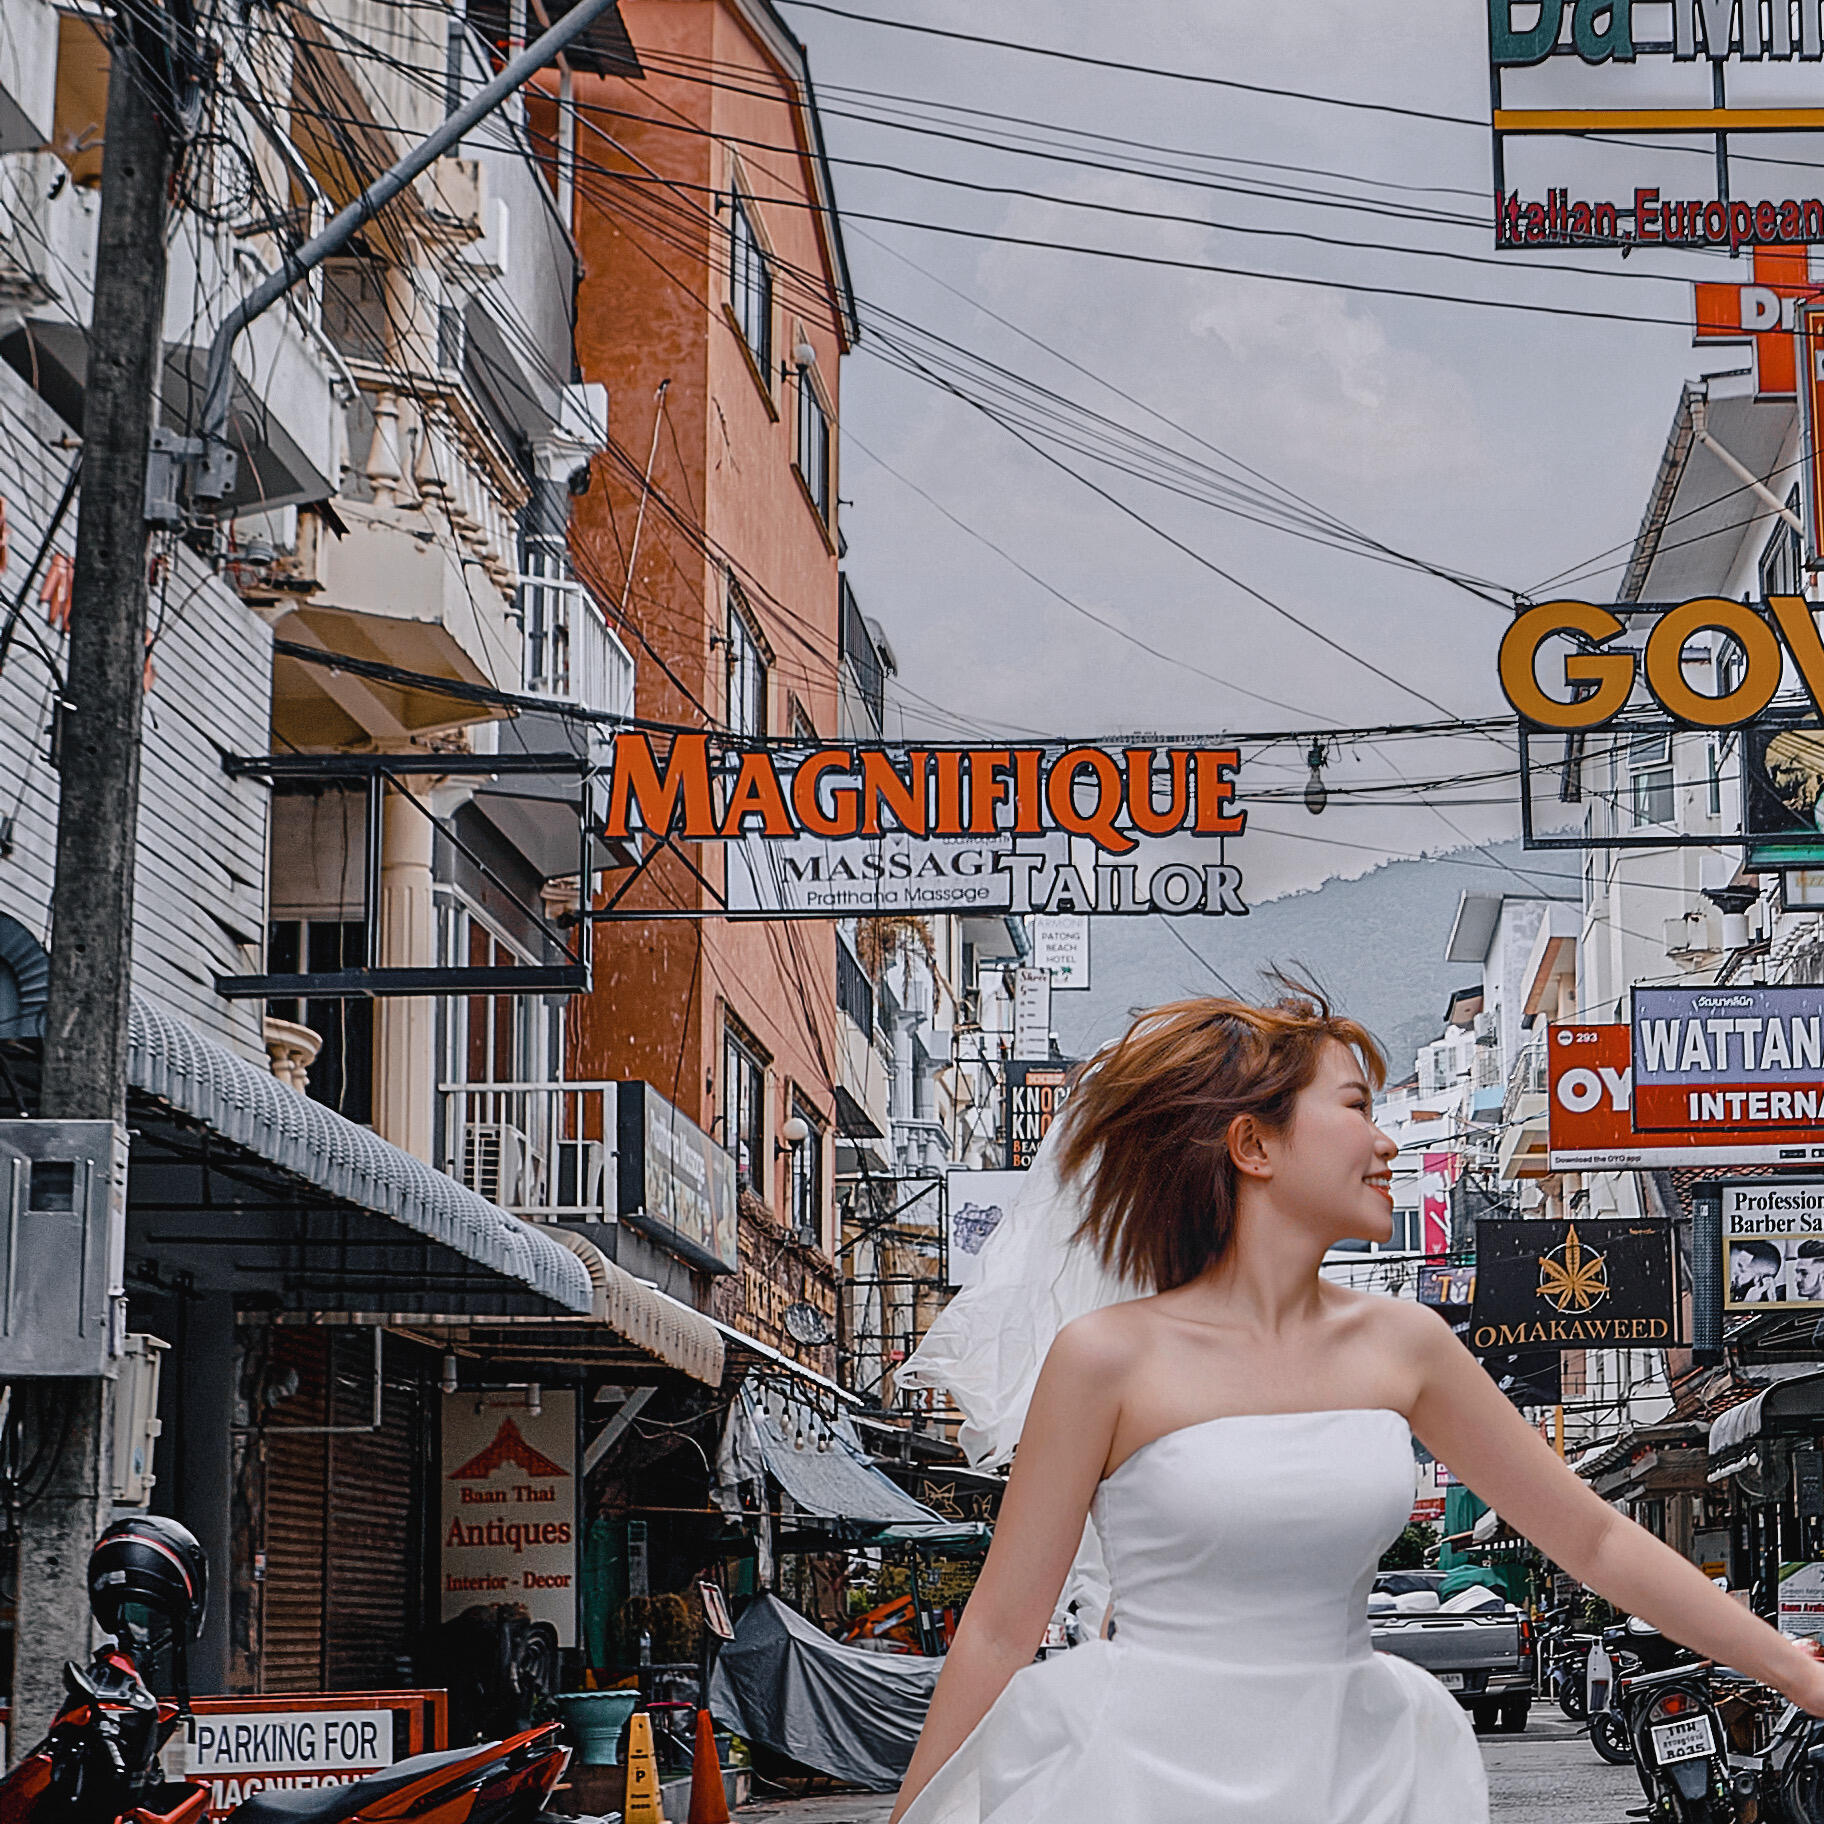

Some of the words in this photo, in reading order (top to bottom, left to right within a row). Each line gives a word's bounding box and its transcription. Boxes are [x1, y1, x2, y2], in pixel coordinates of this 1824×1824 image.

[602, 731, 1250, 855] MAGNIFIQUE
[807, 889, 898, 906] Pratthana
[904, 885, 990, 903] Massage
[997, 853, 1249, 916] TAILOR
[1012, 1086, 1072, 1113] KNOC
[1557, 1067, 1632, 1113] OY
[1730, 1213, 1796, 1233] Barber
[1474, 1317, 1669, 1348] OMAKAWEED
[461, 1487, 507, 1504] Baan
[511, 1485, 556, 1503] Thai
[446, 1516, 572, 1554] Antiques
[446, 1572, 509, 1592] Interior
[523, 1571, 572, 1589] Decor
[197, 1722, 316, 1764] PARKING
[325, 1720, 378, 1760] FOR
